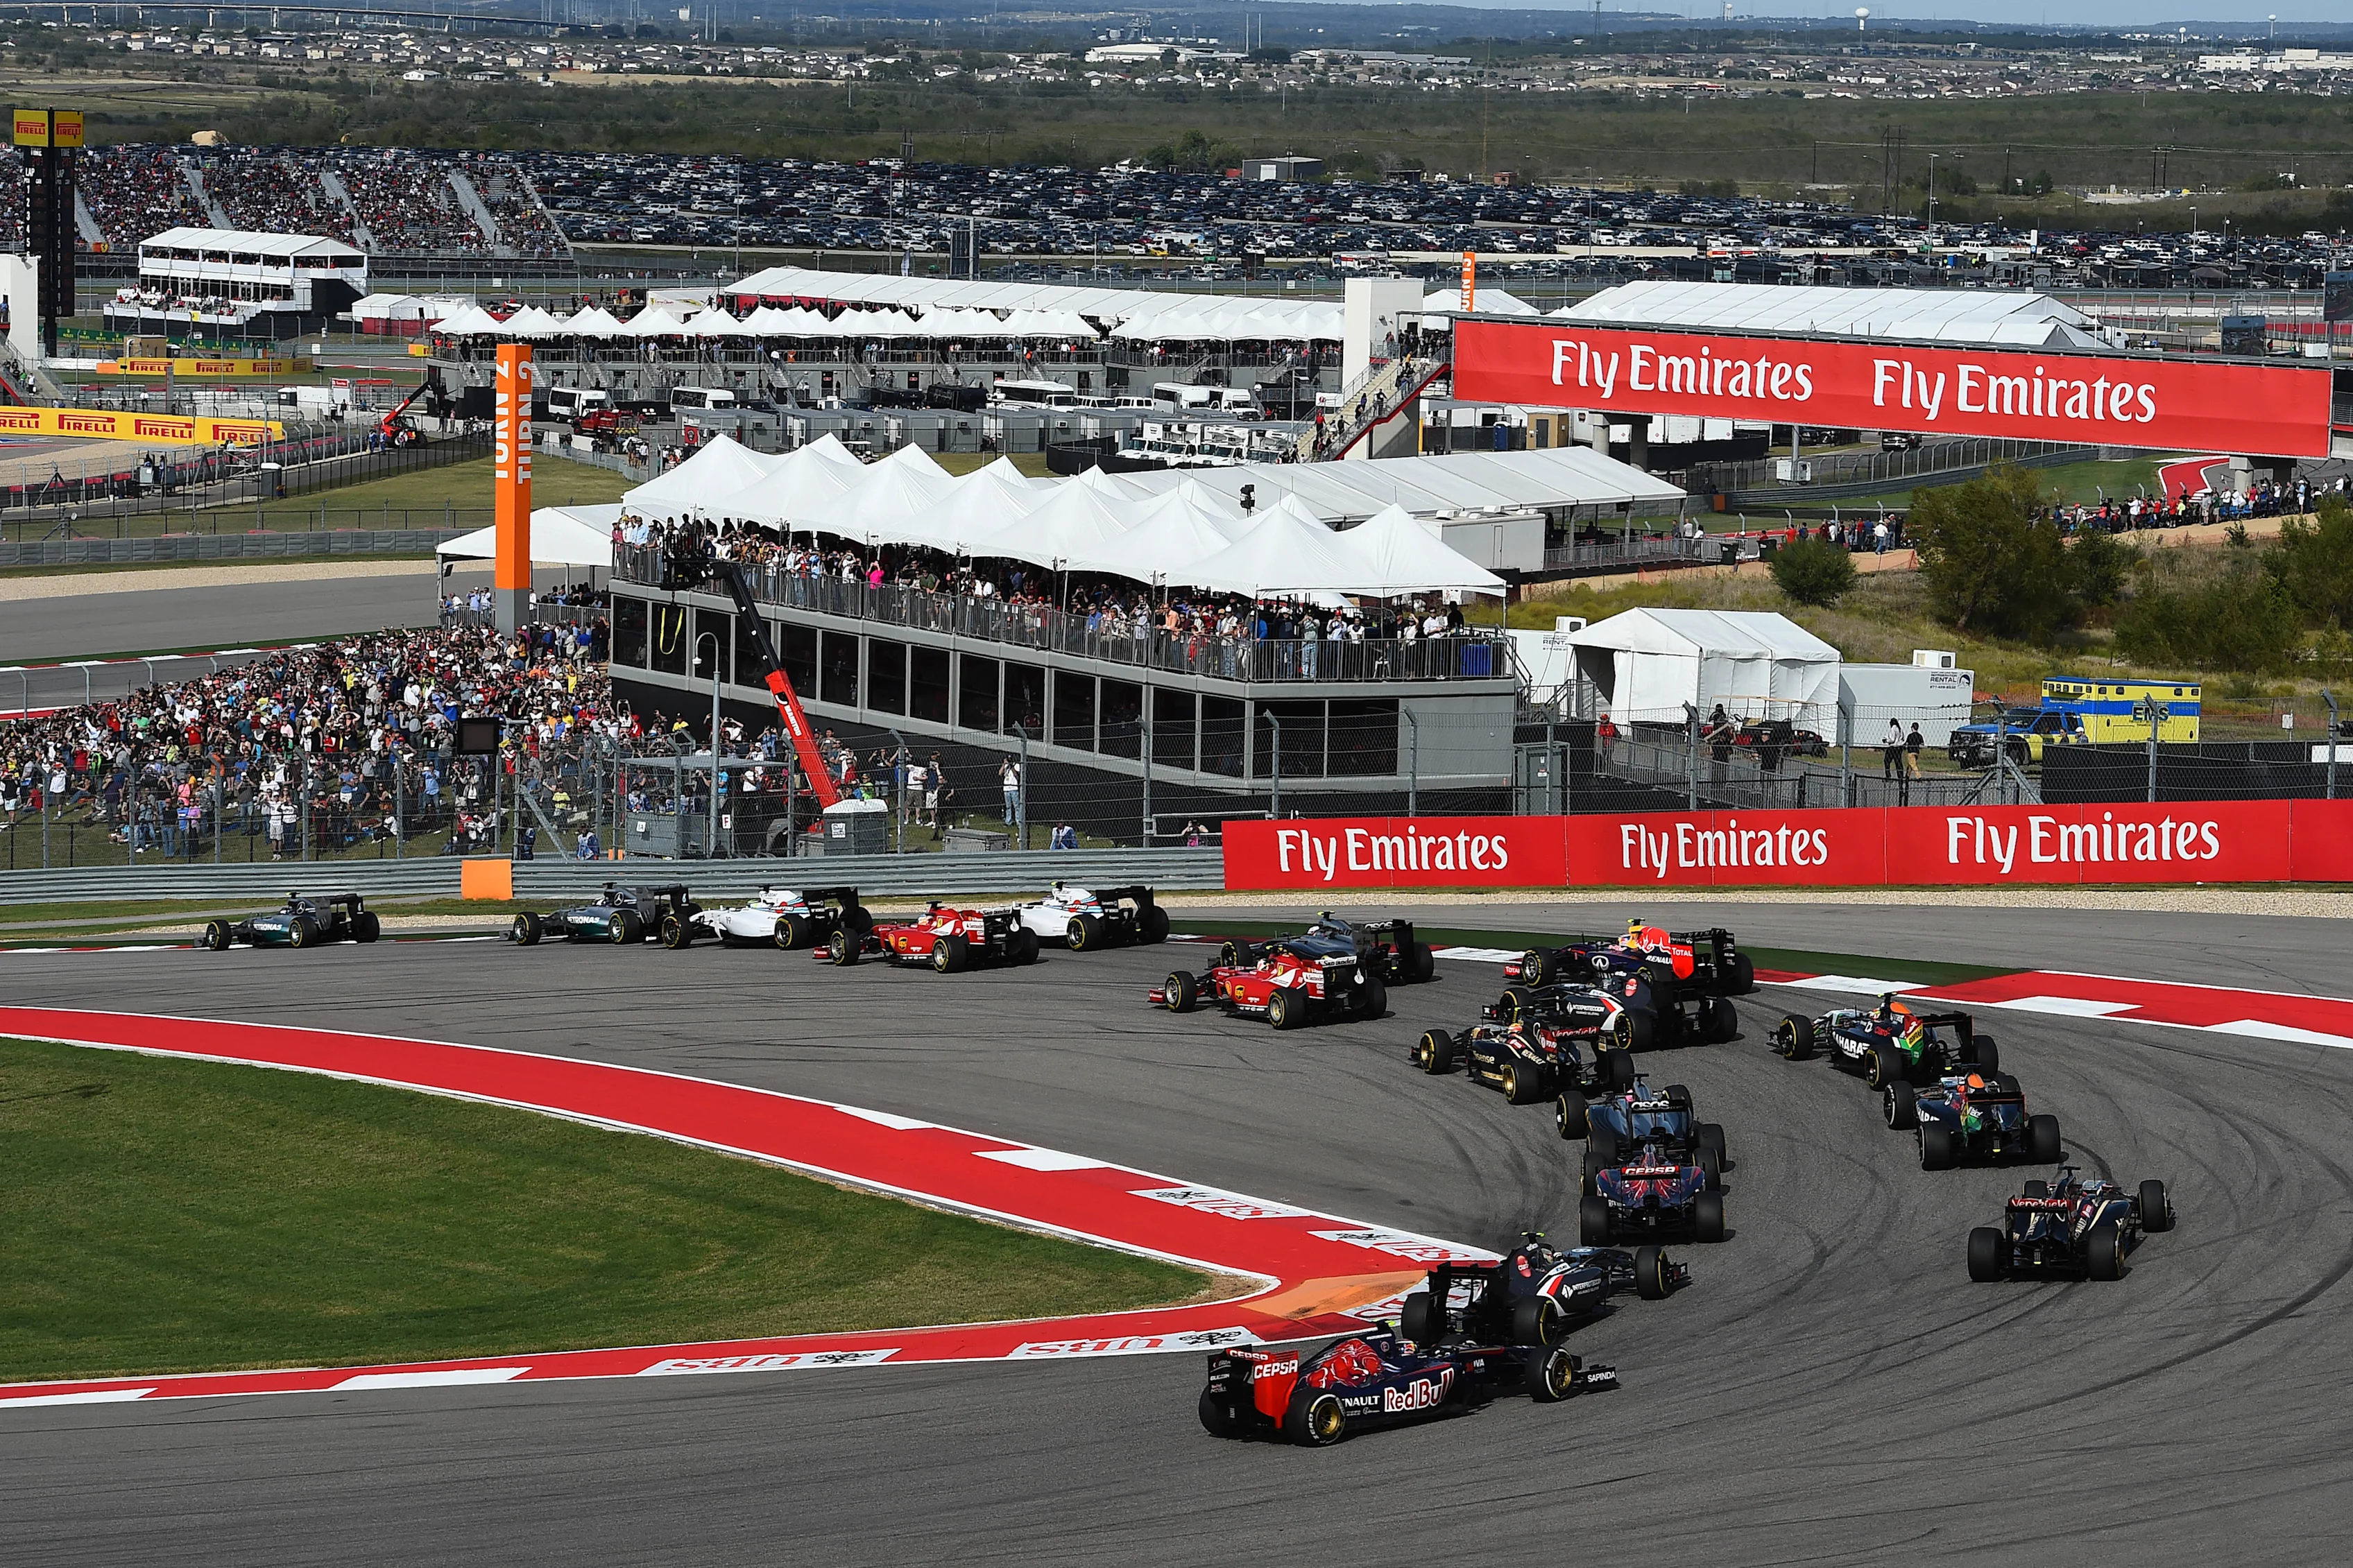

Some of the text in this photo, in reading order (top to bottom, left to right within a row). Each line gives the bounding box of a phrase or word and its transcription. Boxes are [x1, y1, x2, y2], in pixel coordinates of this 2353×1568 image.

[17, 121, 45, 135] PIRELLI
[56, 123, 81, 135] PIRELLI
[25, 168, 35, 177] LAP
[26, 185, 30, 194] 1
[26, 198, 31, 207] 2
[26, 211, 31, 221] 3
[26, 225, 31, 234] 4
[26, 238, 31, 247] 5
[196, 362, 234, 372] PIRELLI
[253, 362, 282, 372] PIRELLI
[1551, 340, 1813, 402] Fly Emirates
[1872, 359, 2156, 423] Fly Emirates
[0, 412, 40, 429] RELLI
[58, 414, 116, 433] PIRELLI
[135, 419, 194, 439] PIRELLI
[784, 705, 802, 736] MANITOU
[2133, 707, 2169, 721] EMS
[1620, 820, 1828, 878] Fly Emirates
[1946, 811, 2220, 874] Fly Emirates
[1277, 825, 1508, 881] Fly Emirates
[1672, 947, 1693, 957] TOTAL
[1645, 955, 1672, 965] RENAU
[1521, 1049, 1546, 1065] RENAULT
[1631, 1100, 1670, 1109] asos
[1229, 1350, 1269, 1361] CEPSA
[1253, 1359, 1299, 1379] CEPSA
[1587, 1370, 1616, 1383] SAPINDA
[1384, 1367, 1455, 1412] Red Bull
[1341, 1395, 1380, 1407] NAULT
[1308, 1413, 1319, 1440] ZERO
